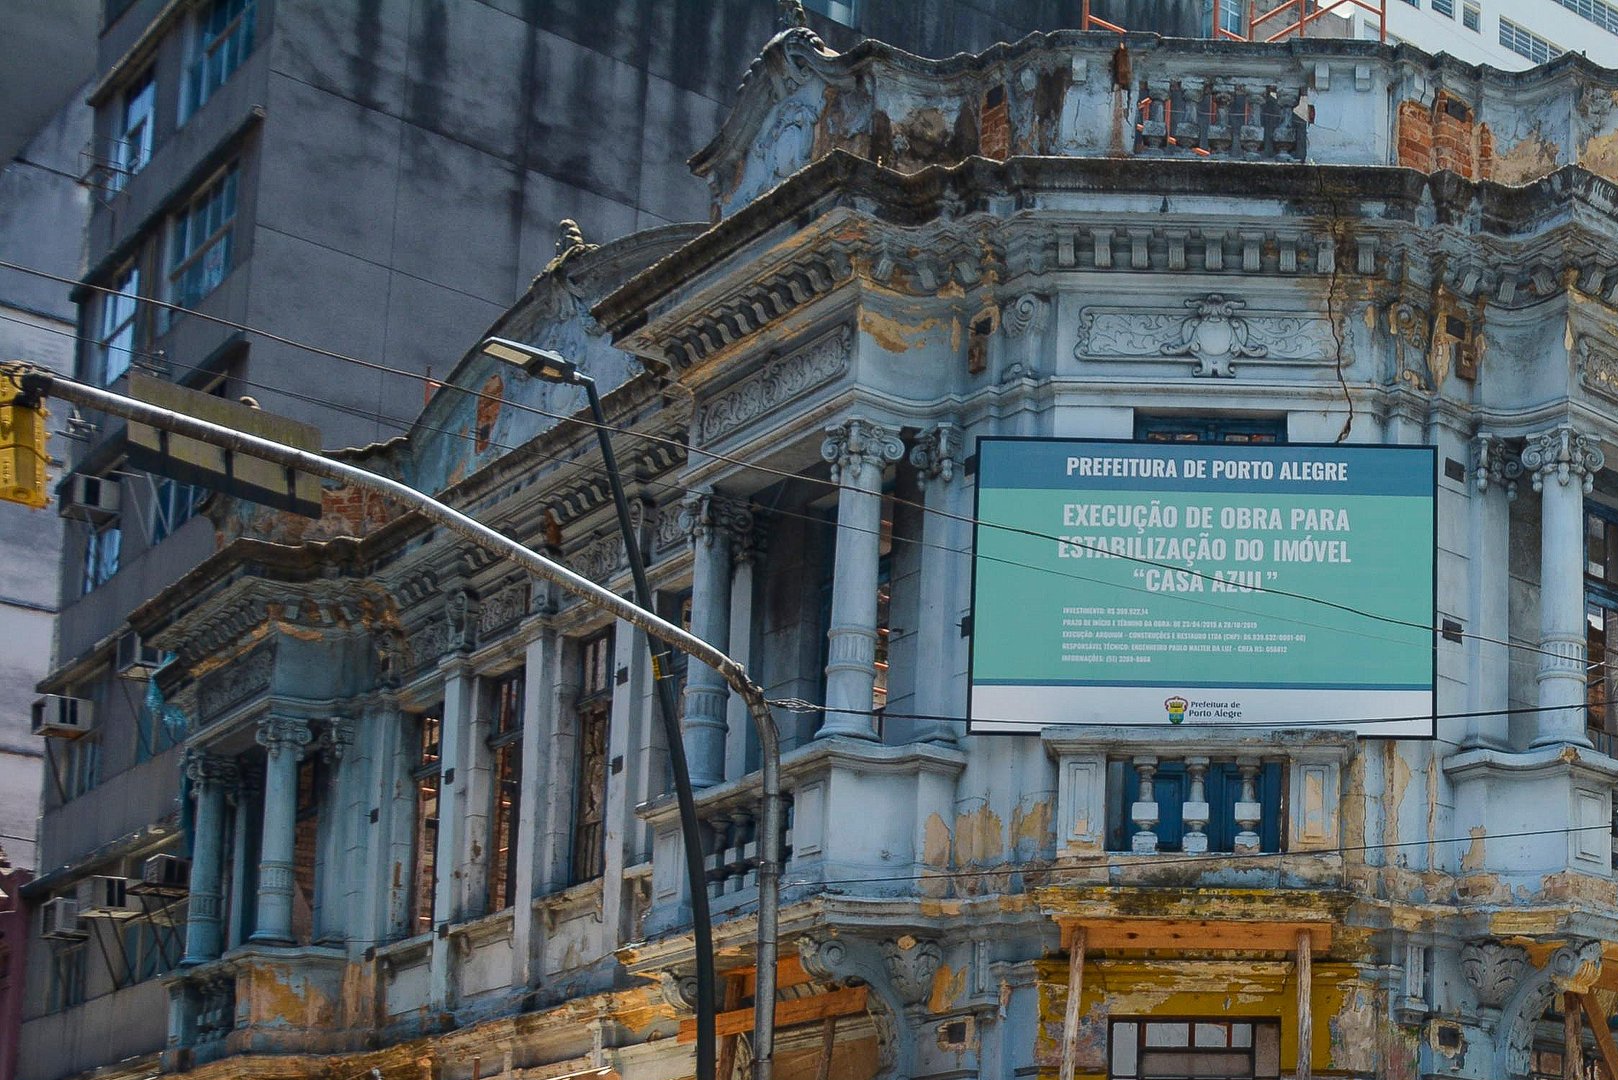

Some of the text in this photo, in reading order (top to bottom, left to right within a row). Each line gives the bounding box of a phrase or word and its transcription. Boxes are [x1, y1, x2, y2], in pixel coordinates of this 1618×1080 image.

[1066, 457, 1348, 481] PREFEITURA DE PORTO ALEGRE
[1063, 500, 1350, 534] EXECUÇÃO DE OBRA PARA
[1058, 532, 1351, 567] ESTABILIZAÇÃO DO IMÓVEL
[1189, 709, 1242, 718] Porto Alegre
